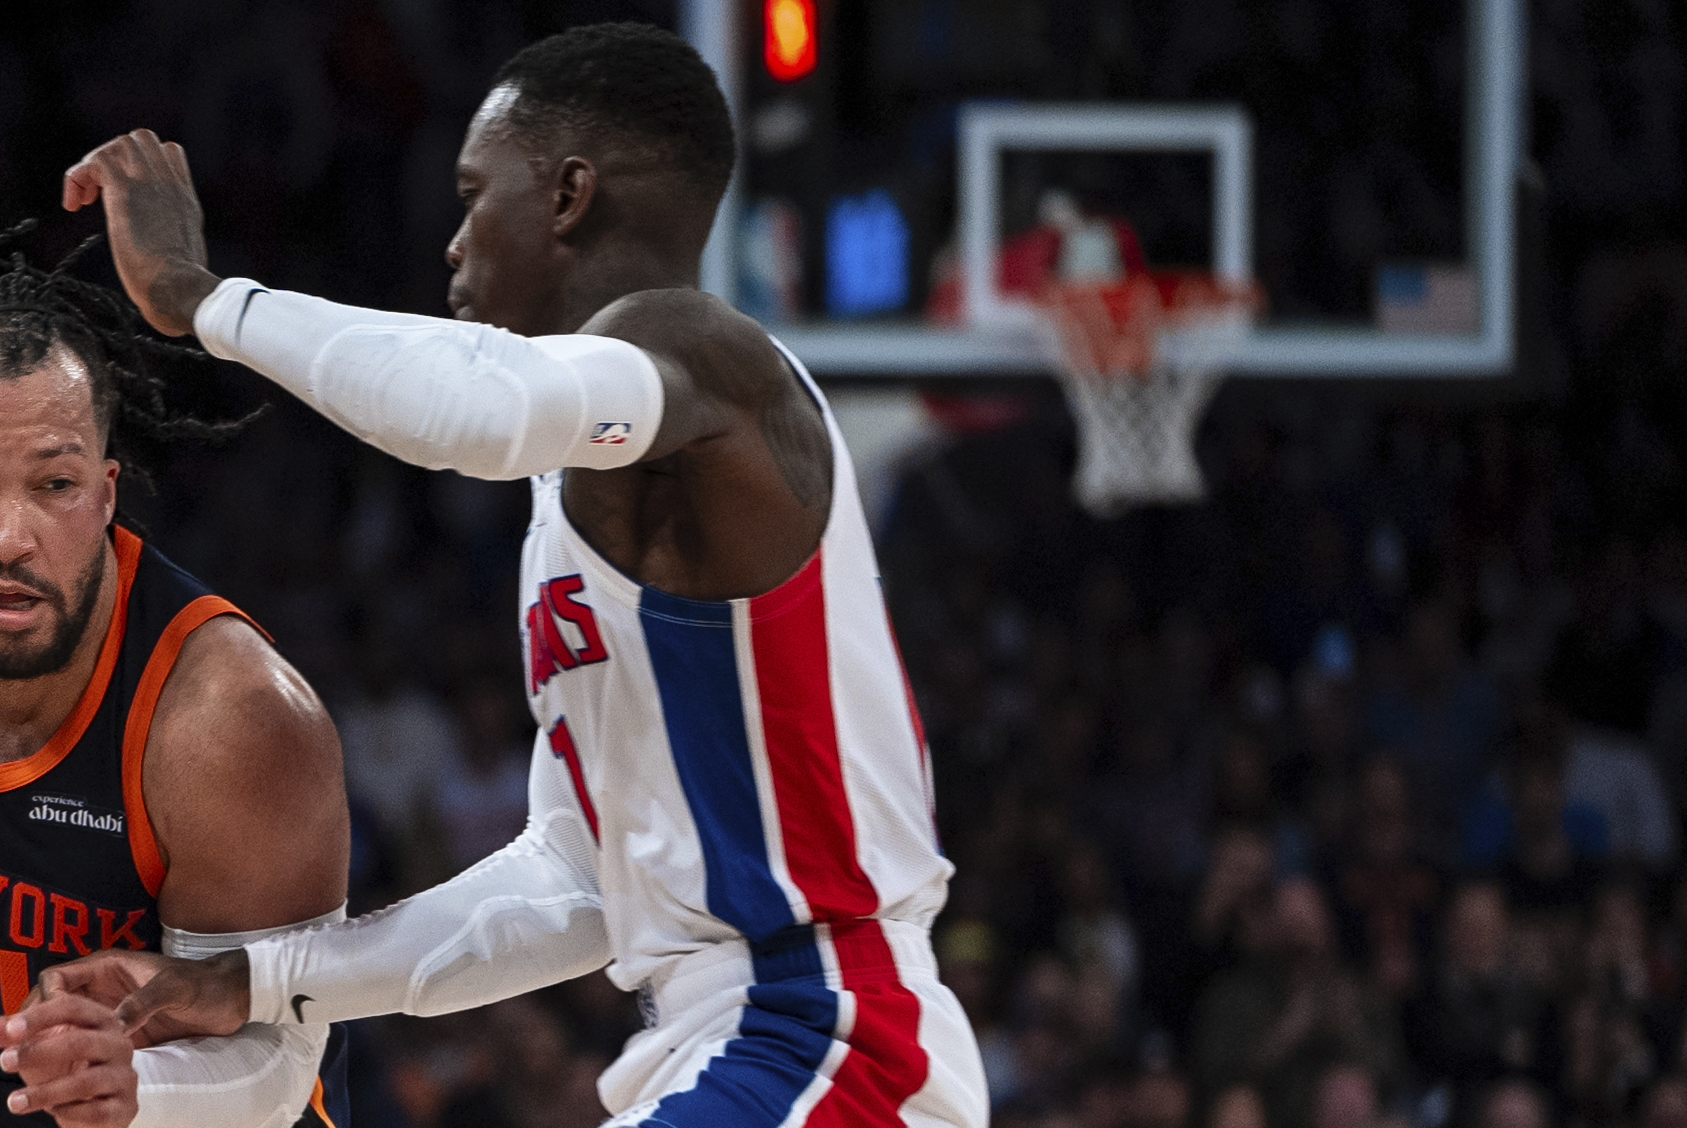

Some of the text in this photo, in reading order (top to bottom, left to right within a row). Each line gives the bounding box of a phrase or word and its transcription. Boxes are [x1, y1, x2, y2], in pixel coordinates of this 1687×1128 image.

[32, 795, 85, 807] experience
[28, 804, 124, 833] abu dhabi
